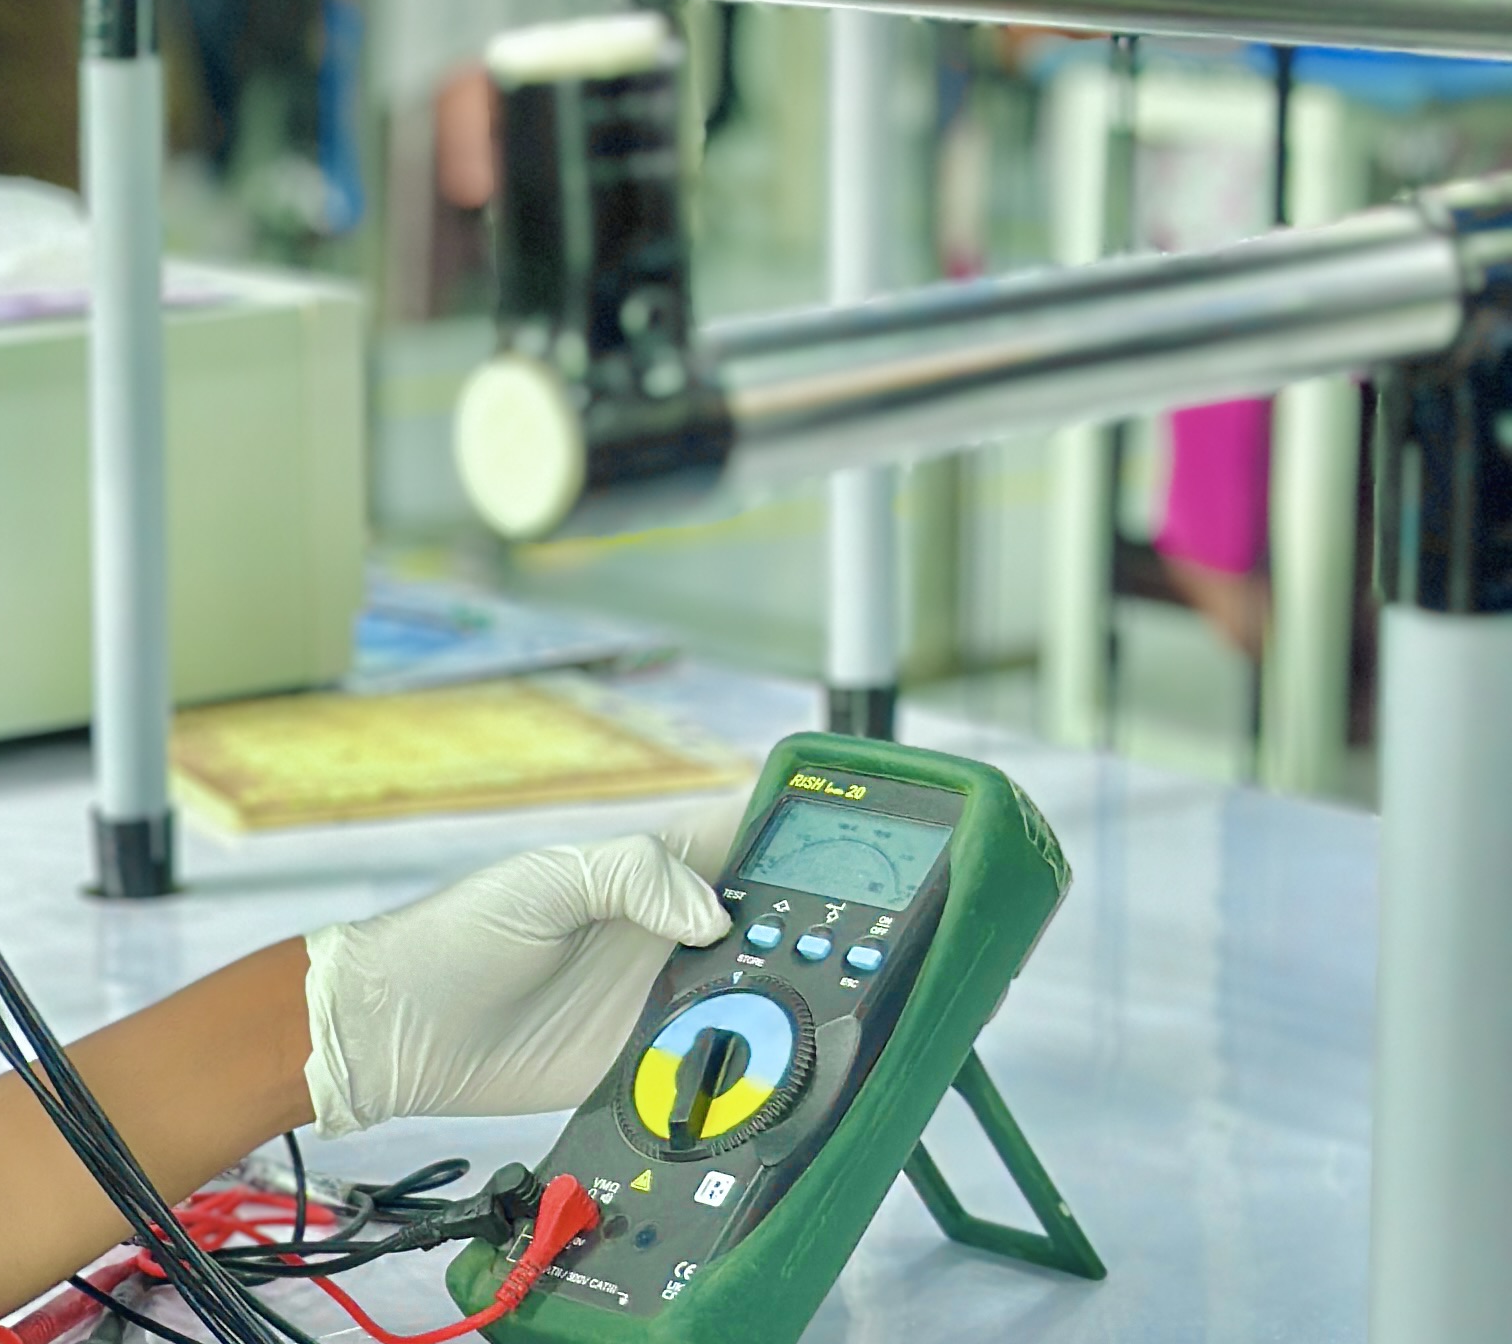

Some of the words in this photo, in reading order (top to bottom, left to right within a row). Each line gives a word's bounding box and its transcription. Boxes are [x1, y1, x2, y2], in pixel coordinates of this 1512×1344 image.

[789, 773, 827, 791] RISH
[845, 785, 867, 800] 20
[723, 889, 747, 901] TEST
[737, 954, 766, 967] STORE
[674, 1261, 697, 1281] CE
